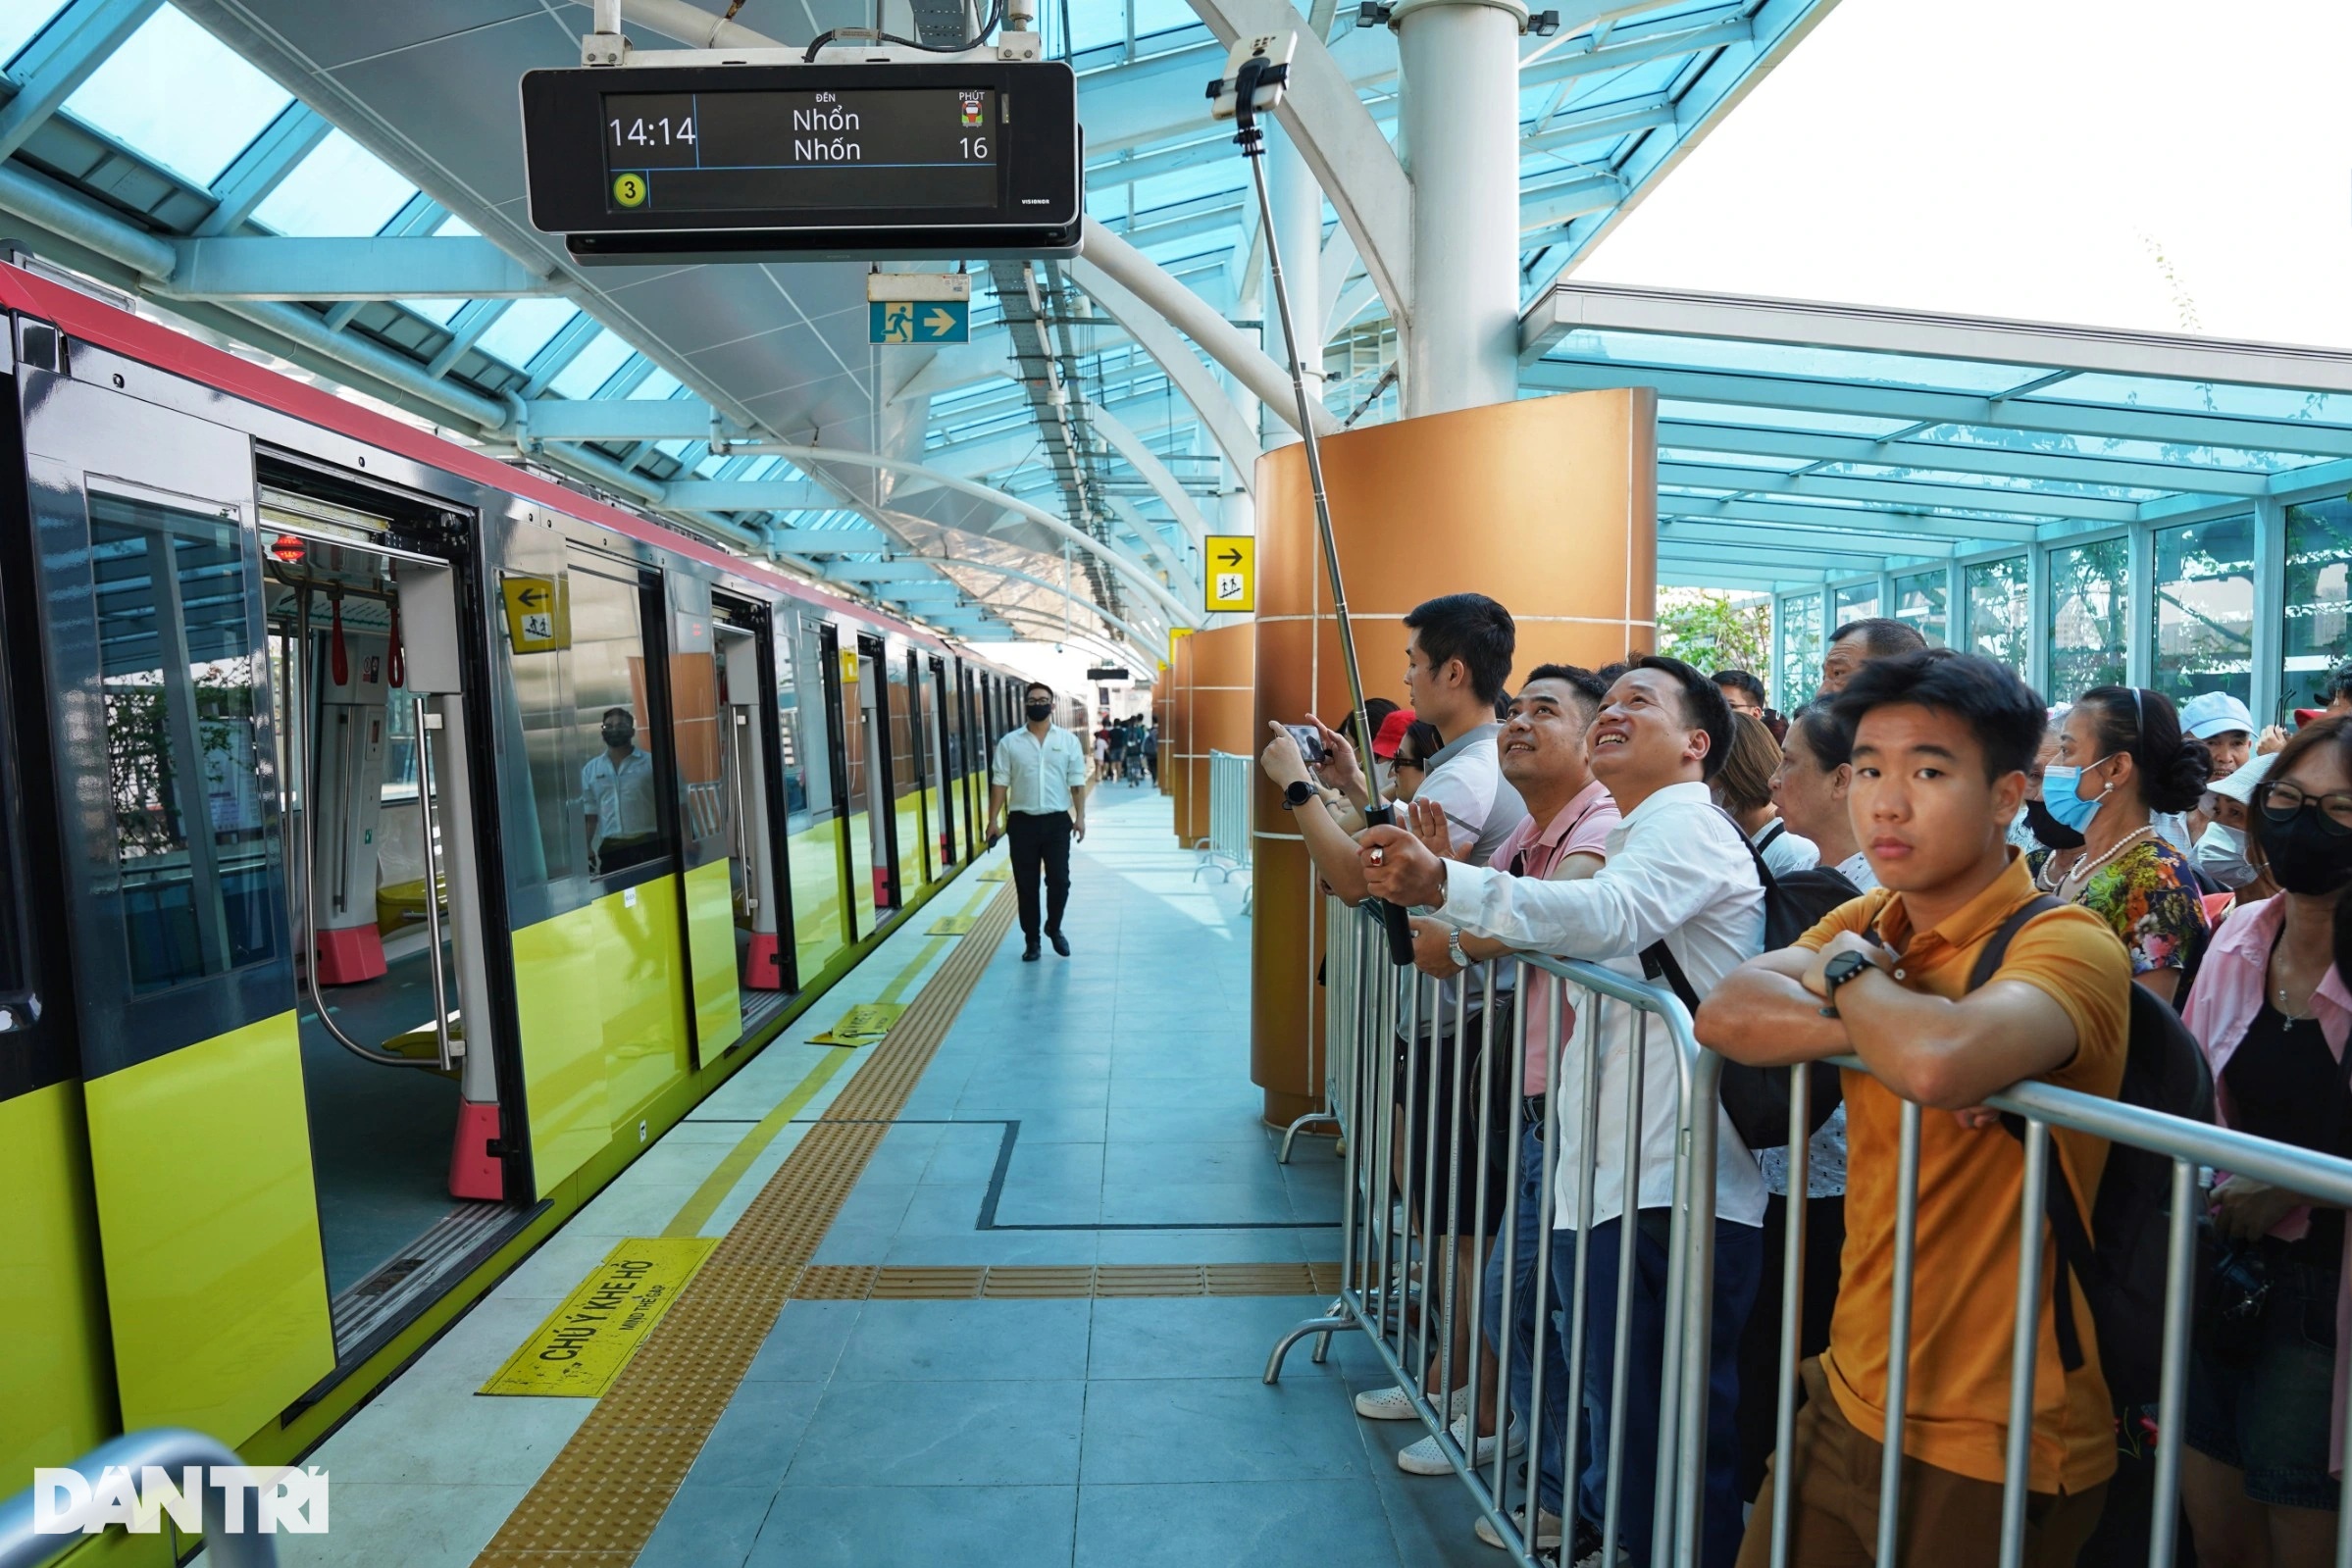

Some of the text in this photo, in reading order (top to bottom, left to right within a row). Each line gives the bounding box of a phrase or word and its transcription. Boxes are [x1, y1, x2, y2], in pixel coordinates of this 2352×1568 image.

[815, 91, 836, 103] ĐẾN
[958, 90, 986, 101] PHÚT
[793, 104, 859, 130] Nhổn
[610, 117, 696, 146] 14:14
[794, 136, 861, 161] Nhốn
[959, 136, 988, 159] 16
[624, 180, 637, 199] 3
[634, 1297, 657, 1312] THE
[538, 1327, 597, 1361] CHÚ
[582, 1282, 638, 1310] KHE
